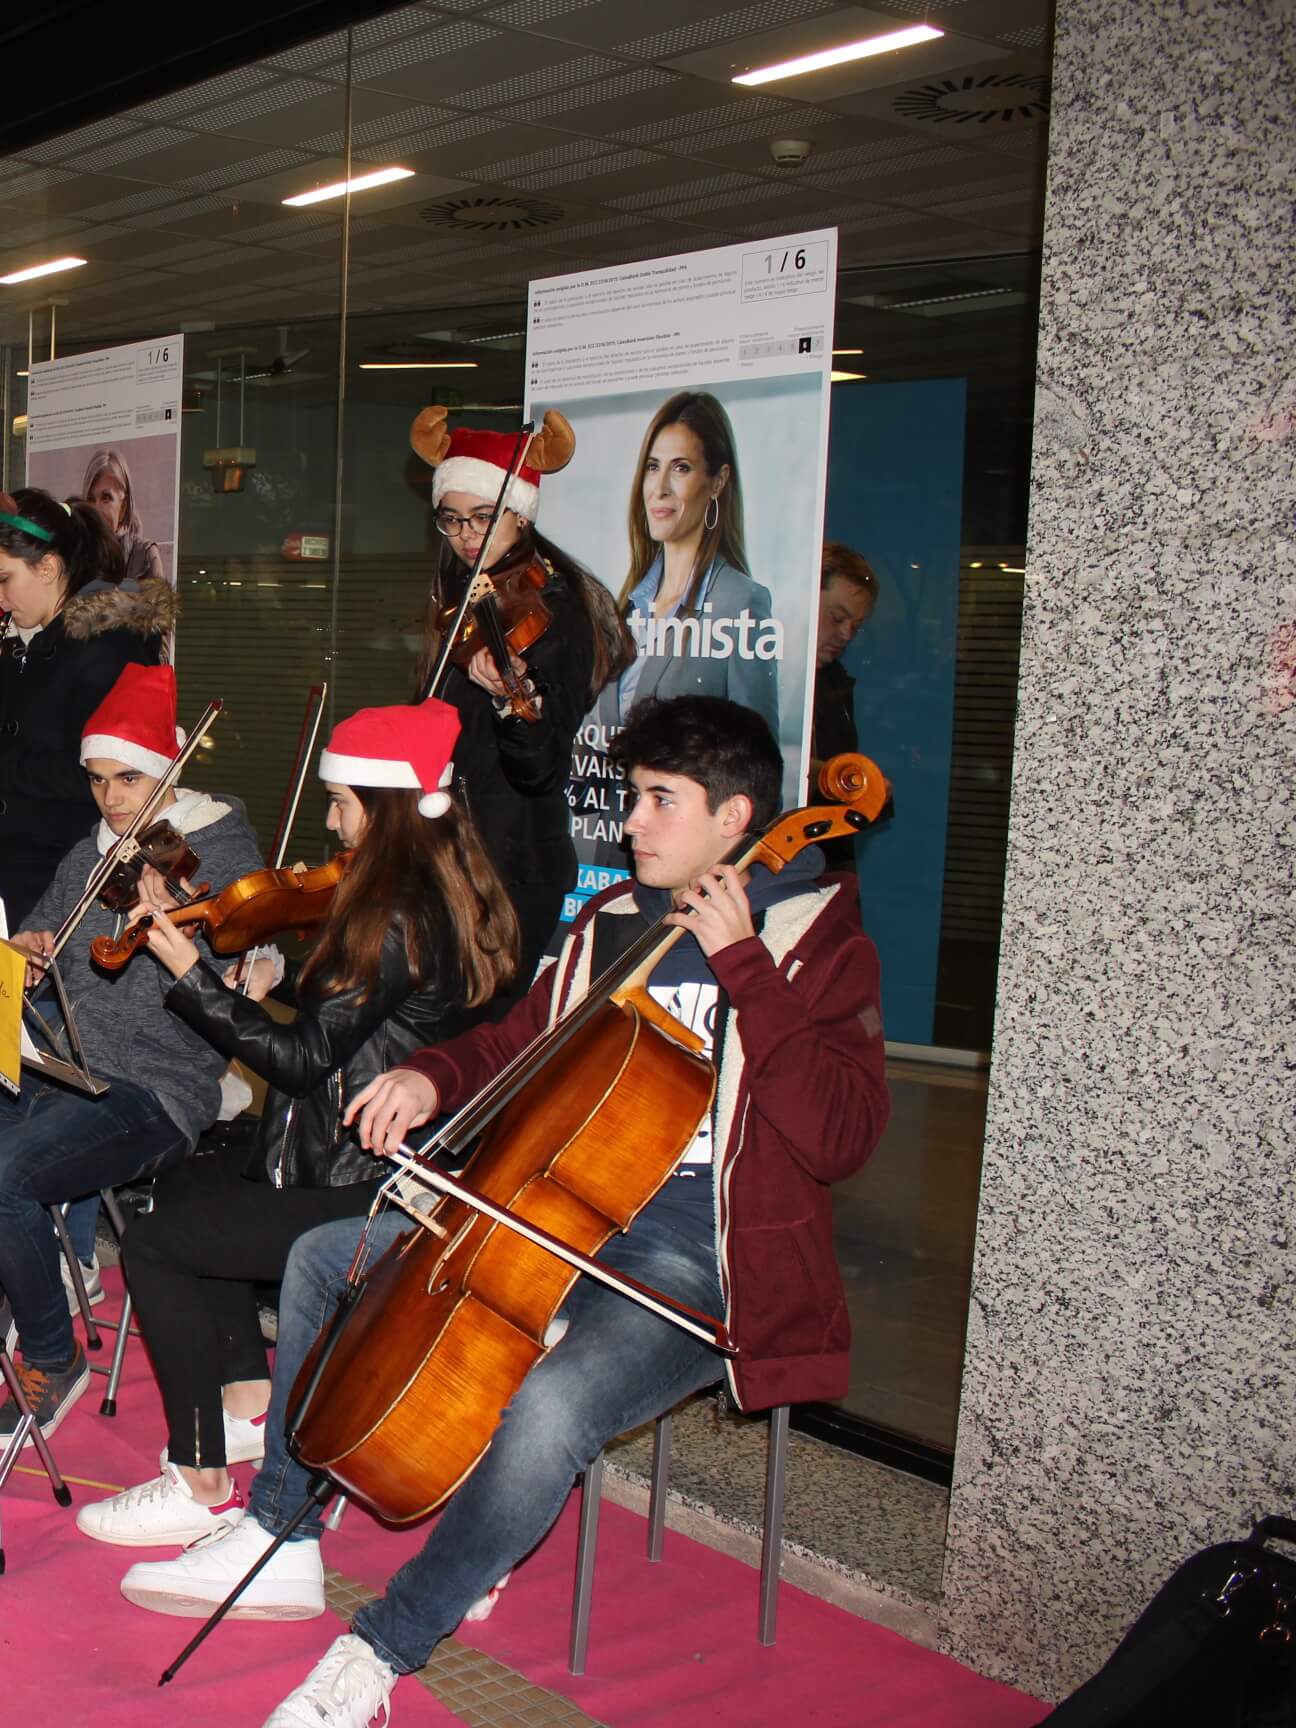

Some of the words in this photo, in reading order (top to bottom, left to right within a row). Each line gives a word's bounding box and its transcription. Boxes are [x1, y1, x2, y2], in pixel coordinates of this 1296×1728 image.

[626, 602, 785, 661] timista
[570, 753, 627, 780] VARS
[584, 787, 610, 810] AL
[571, 816, 624, 843] PLAN
